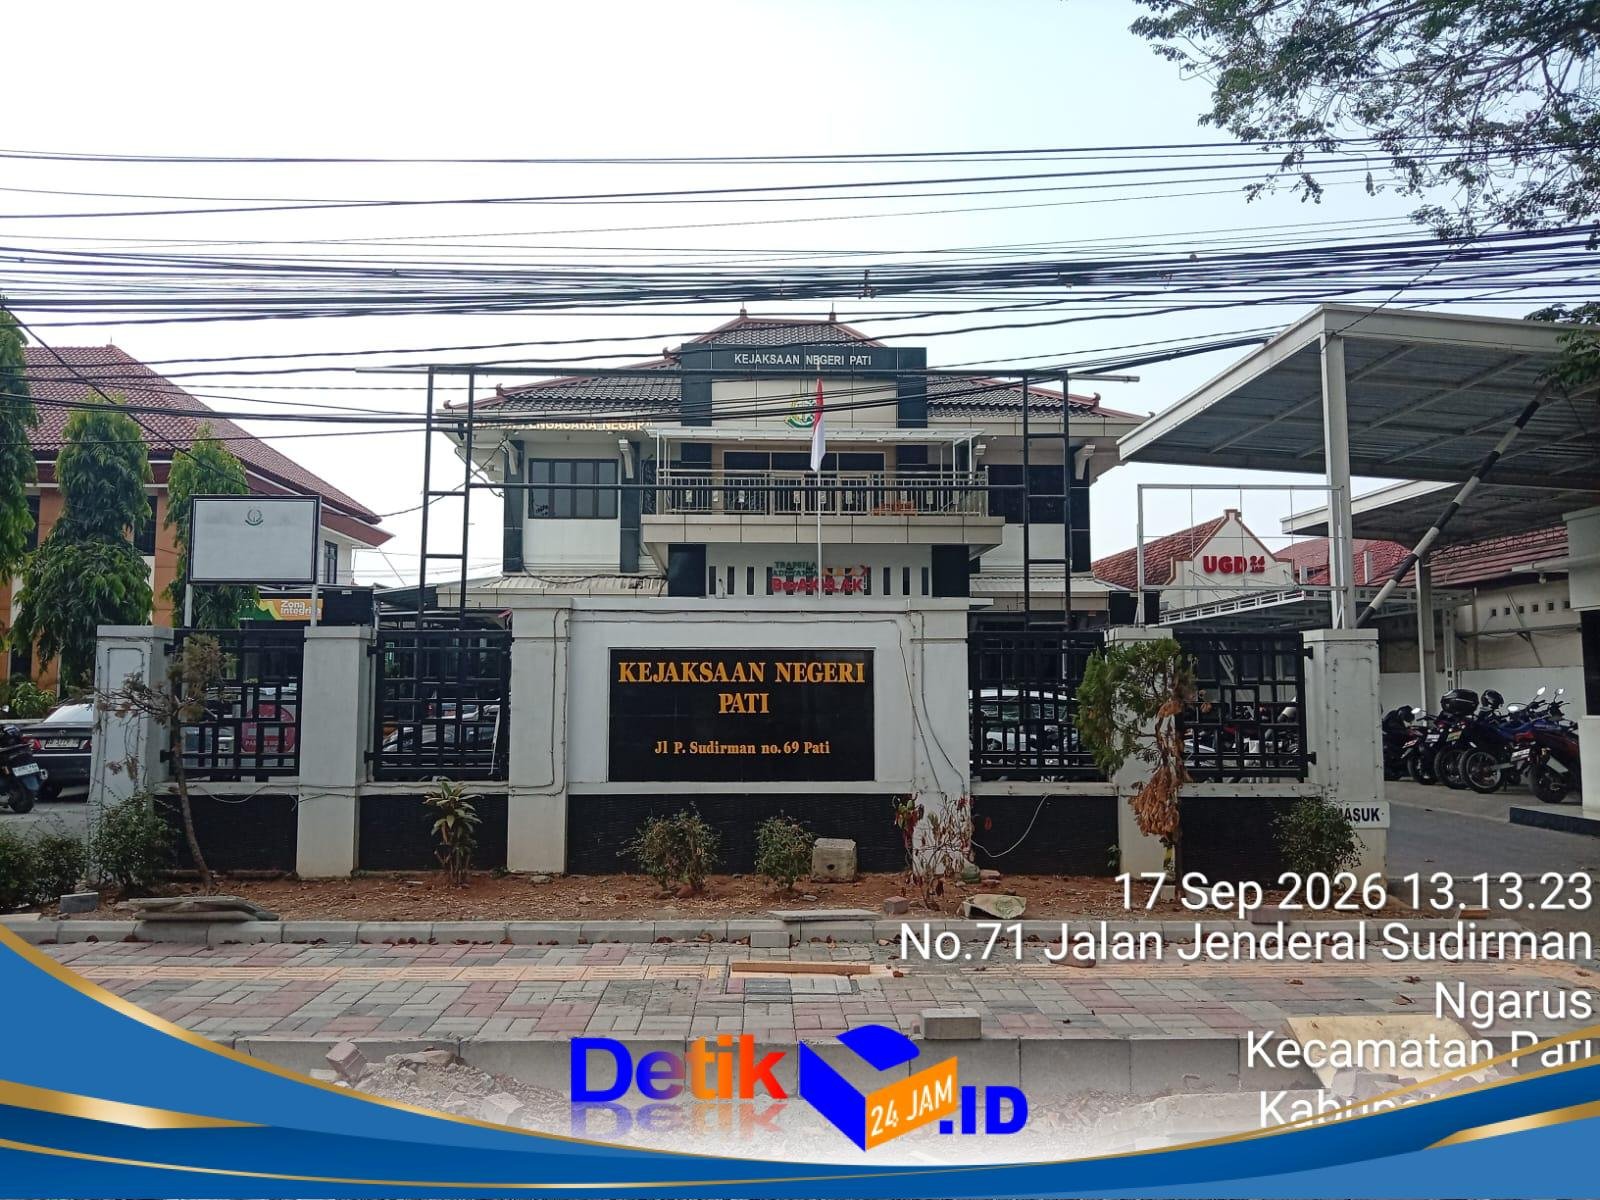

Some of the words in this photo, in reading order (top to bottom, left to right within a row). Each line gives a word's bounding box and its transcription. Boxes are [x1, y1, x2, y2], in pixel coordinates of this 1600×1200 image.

[734, 353, 800, 365] KEJAKSAAN
[806, 354, 845, 366] NEGERI
[850, 355, 872, 366] PATI
[1203, 556, 1247, 574] UGD
[281, 600, 306, 608] Zona
[618, 662, 766, 683] KEJAKSAAN
[775, 662, 865, 683] NEGERI
[718, 693, 769, 714] PATI
[655, 741, 668, 754] Jl
[674, 741, 686, 754] P.
[689, 741, 756, 754] Sudirman
[803, 741, 831, 754] Pati
[1338, 807, 1380, 822] ASUK
